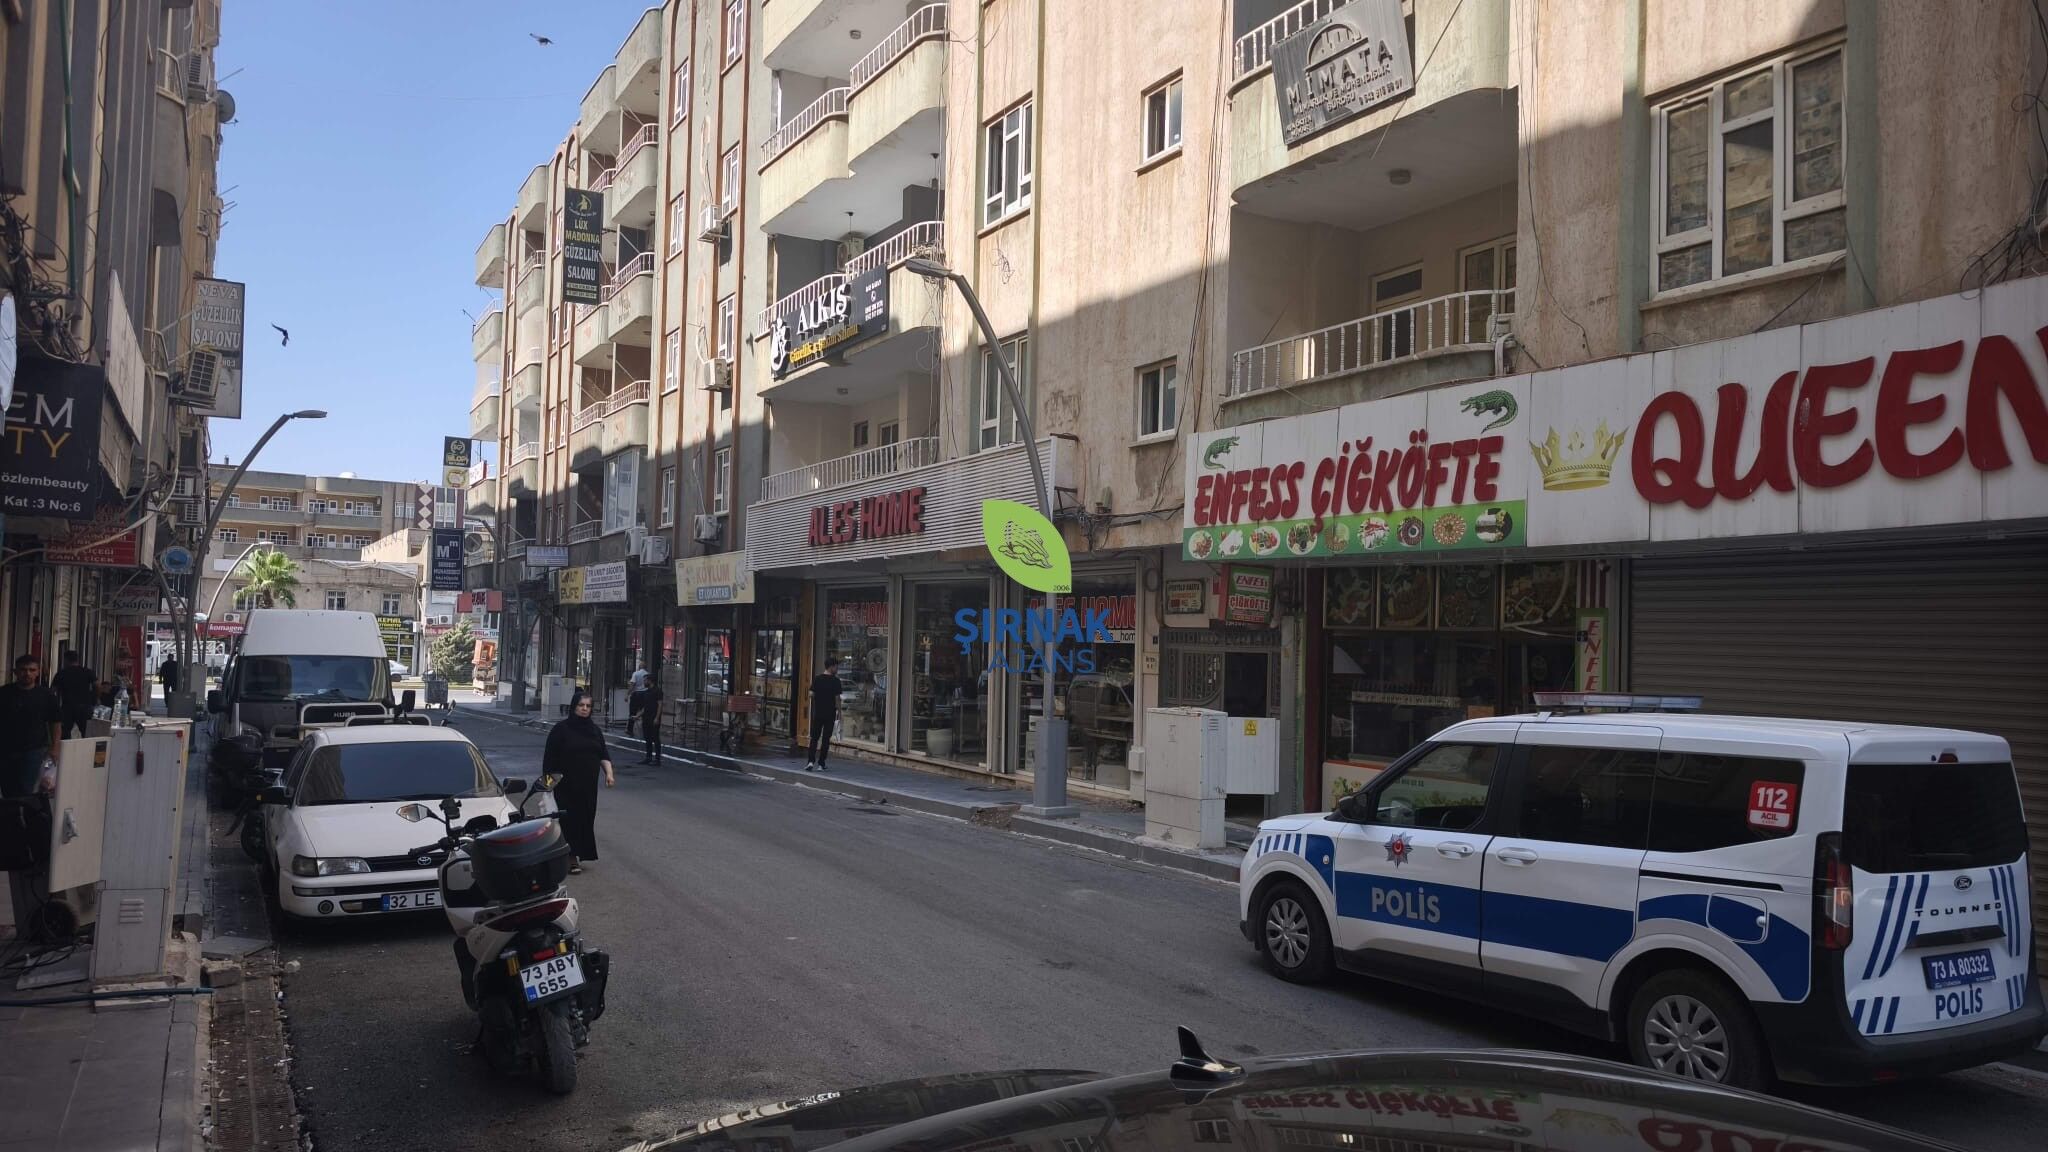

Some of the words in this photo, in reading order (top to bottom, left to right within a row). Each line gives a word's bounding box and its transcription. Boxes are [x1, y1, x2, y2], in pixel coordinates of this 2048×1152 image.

[565, 230, 600, 243] MADONNA
[564, 243, 600, 262] GÜZELLİK
[567, 265, 596, 281] SALONU
[198, 284, 240, 300] NEVA
[193, 328, 241, 349] SALONU
[1, 472, 89, 493] özlembeauty
[1194, 461, 1305, 527] ENFESS
[1311, 428, 1504, 535] ÇİĞKÖFTE
[4, 495, 28, 507] Kat
[49, 500, 81, 512] No:6
[808, 500, 856, 546] ALES
[860, 487, 926, 539] HOME
[1757, 786, 1788, 810] 112
[391, 895, 407, 909] 32
[415, 893, 436, 908] LE
[1371, 886, 1441, 923] POLİS
[522, 967, 542, 983] 73
[547, 954, 576, 975] ABY
[1931, 961, 1947, 980] 73
[1949, 959, 1958, 977] A
[1958, 955, 1990, 976] 80332
[538, 975, 569, 995] 655
[1935, 984, 1983, 1020] POLİS
